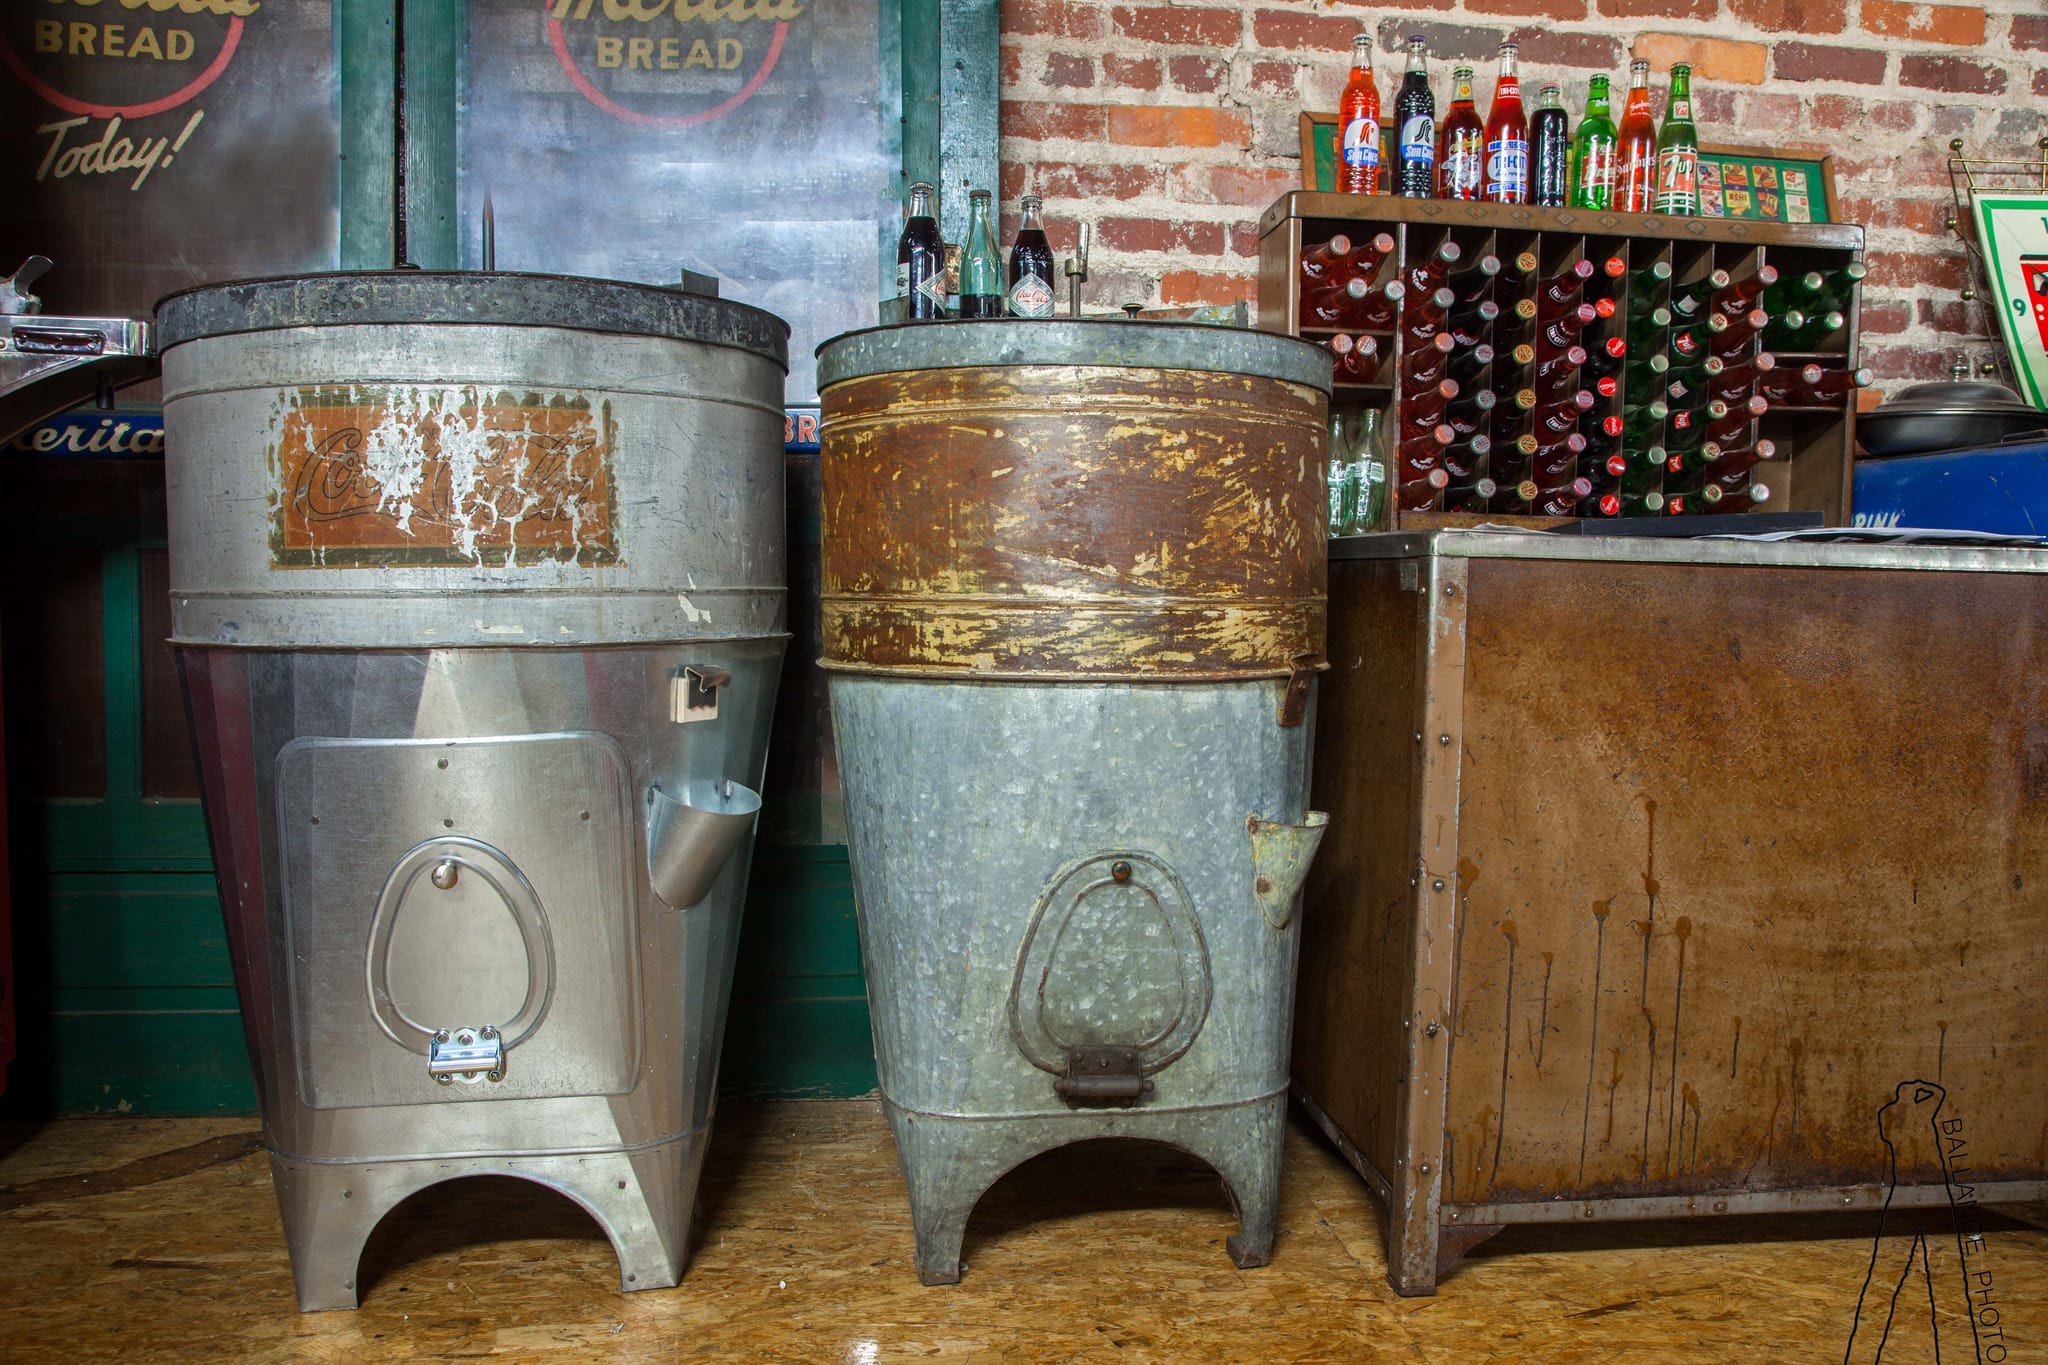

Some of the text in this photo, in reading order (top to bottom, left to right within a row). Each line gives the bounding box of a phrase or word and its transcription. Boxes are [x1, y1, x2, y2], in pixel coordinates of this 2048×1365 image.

[35, 20, 195, 61] BREAD
[597, 37, 744, 71] BREAD
[36, 110, 204, 191] Today!
[2013, 298, 2026, 317] 9
[1852, 512, 1900, 528] RINK
